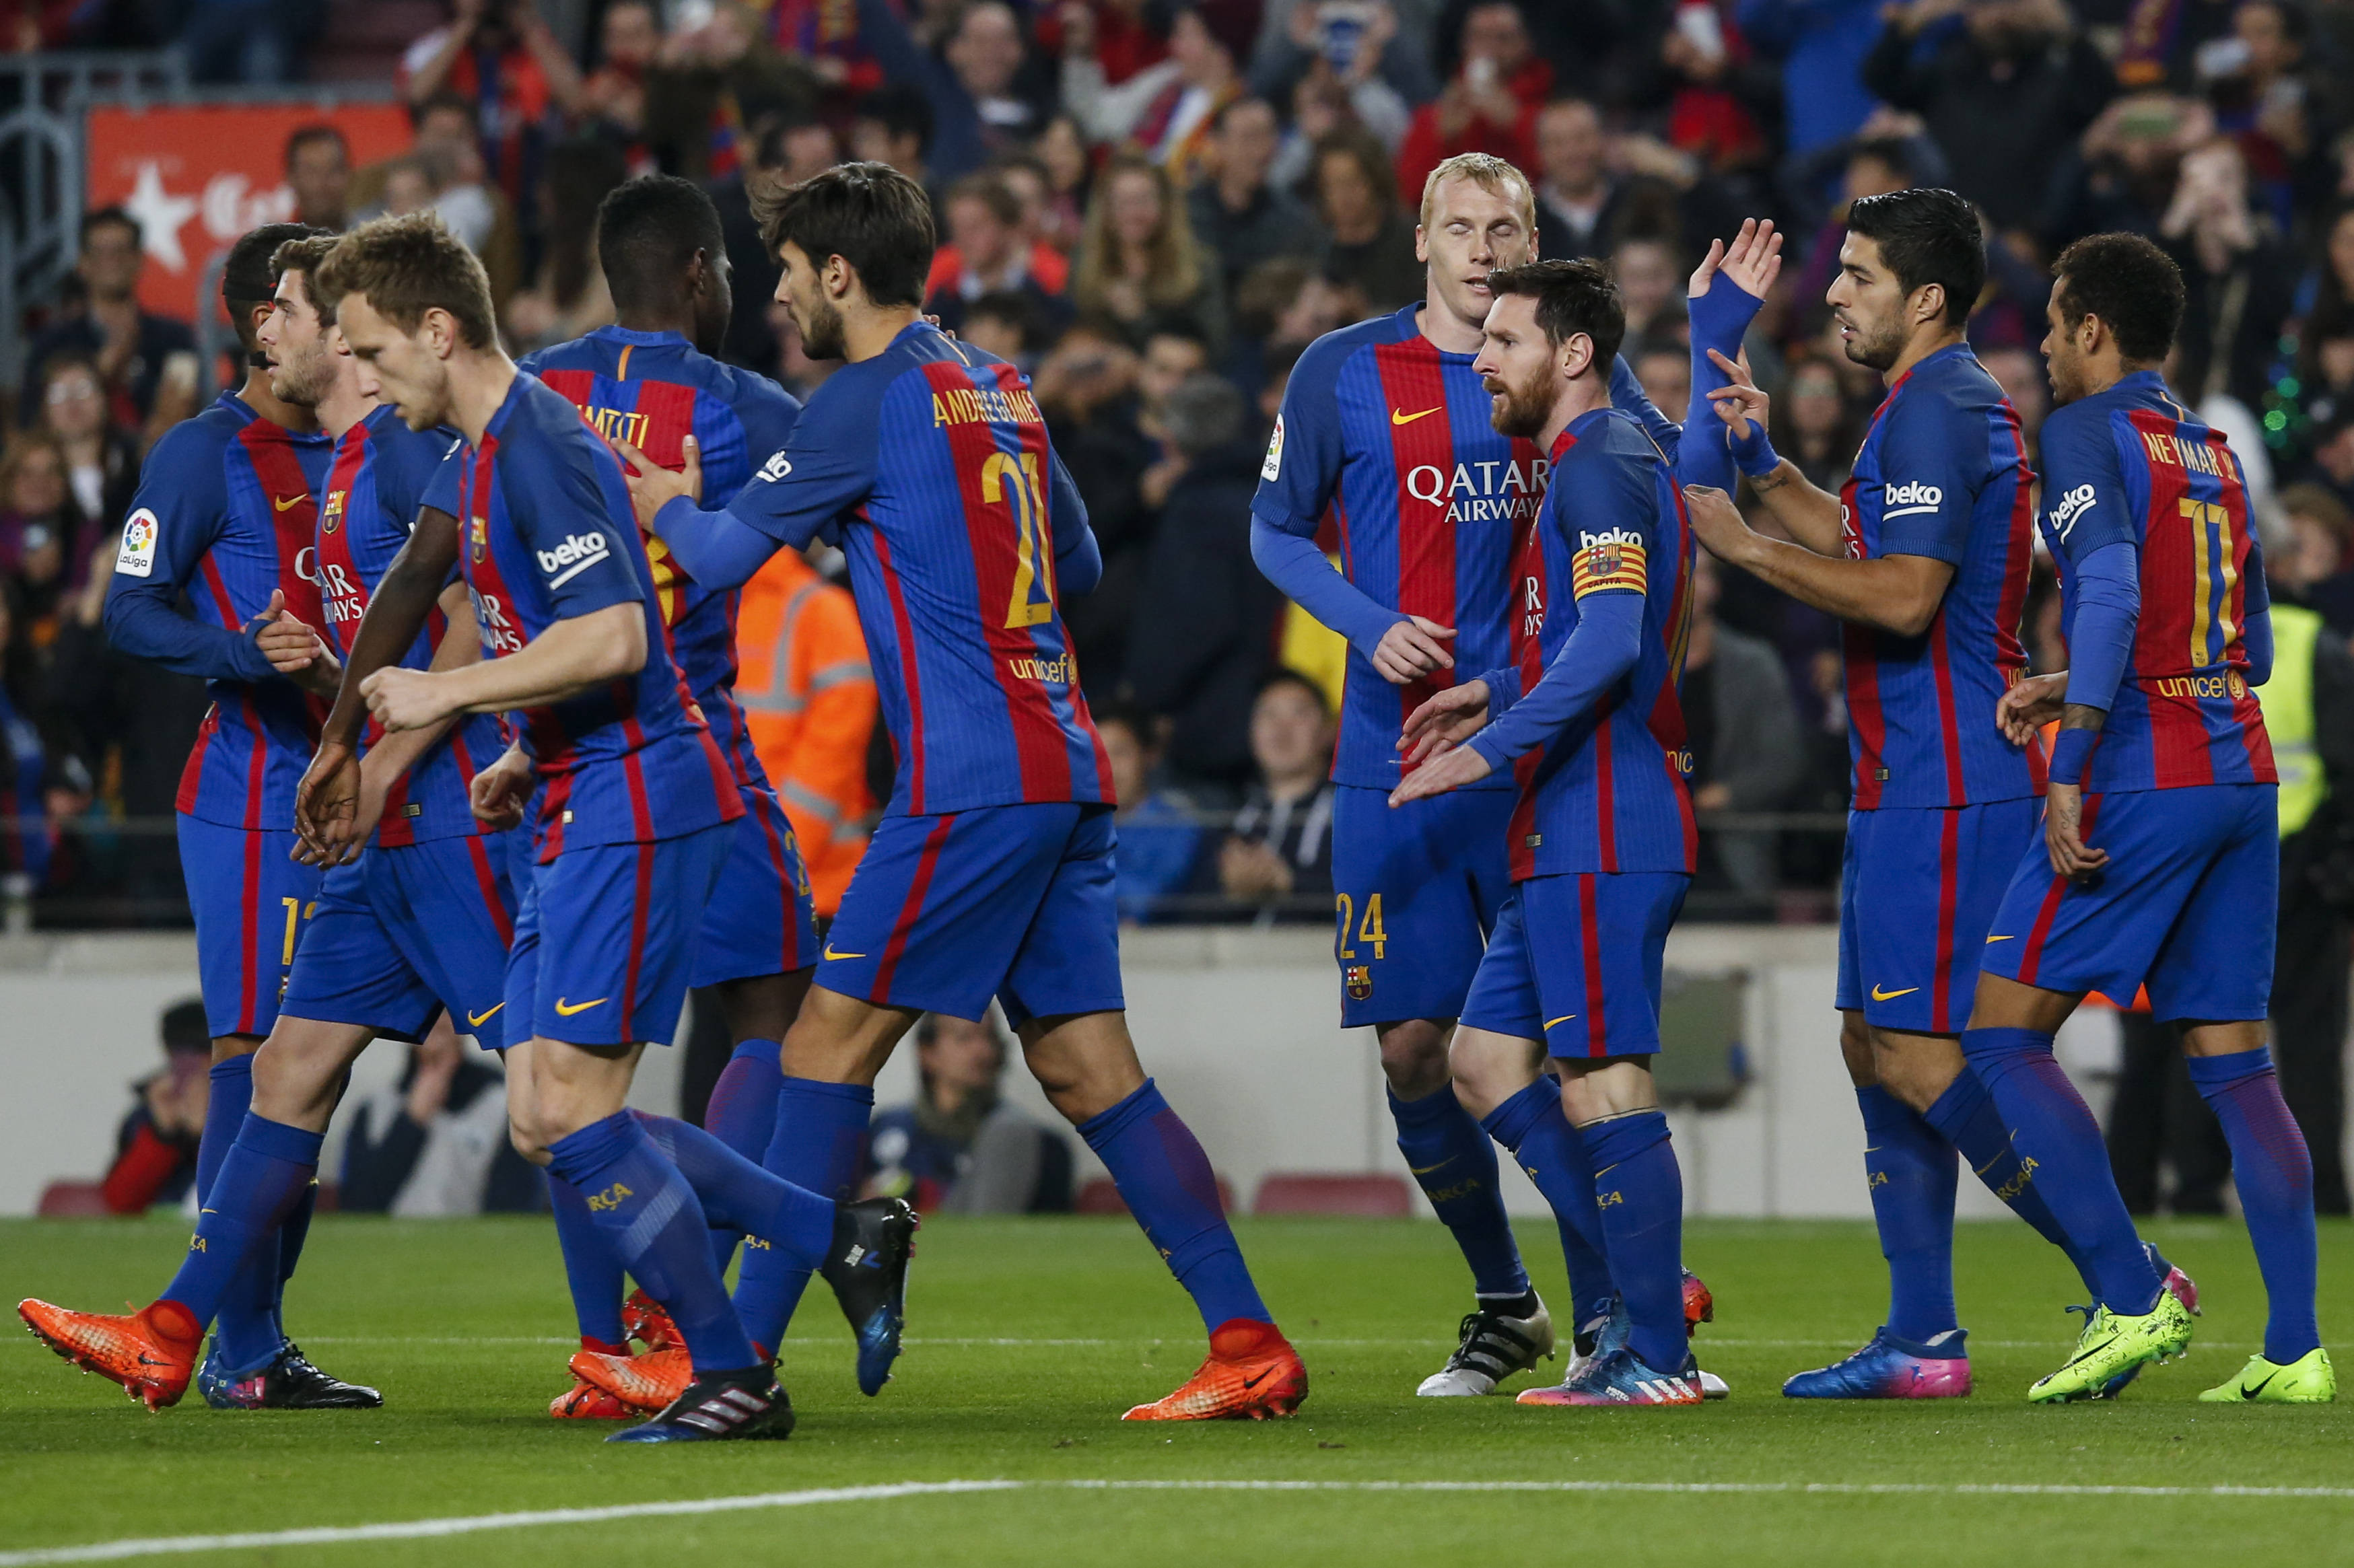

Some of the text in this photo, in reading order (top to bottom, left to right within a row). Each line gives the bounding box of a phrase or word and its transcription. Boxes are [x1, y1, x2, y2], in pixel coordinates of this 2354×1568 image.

[2143, 431, 2223, 477] NEYMAR
[1407, 459, 1549, 507] QATAR
[1885, 480, 1942, 505] beko
[1444, 497, 1540, 523] AIRWAY
[2048, 484, 2095, 530] beko
[120, 554, 147, 567] LaLiga
[536, 531, 606, 573] beko
[981, 452, 1052, 629] 21
[2178, 497, 2238, 668] 11
[1009, 653, 1066, 683] unicef
[2157, 670, 2227, 698] unicef
[1336, 892, 1387, 959] 24
